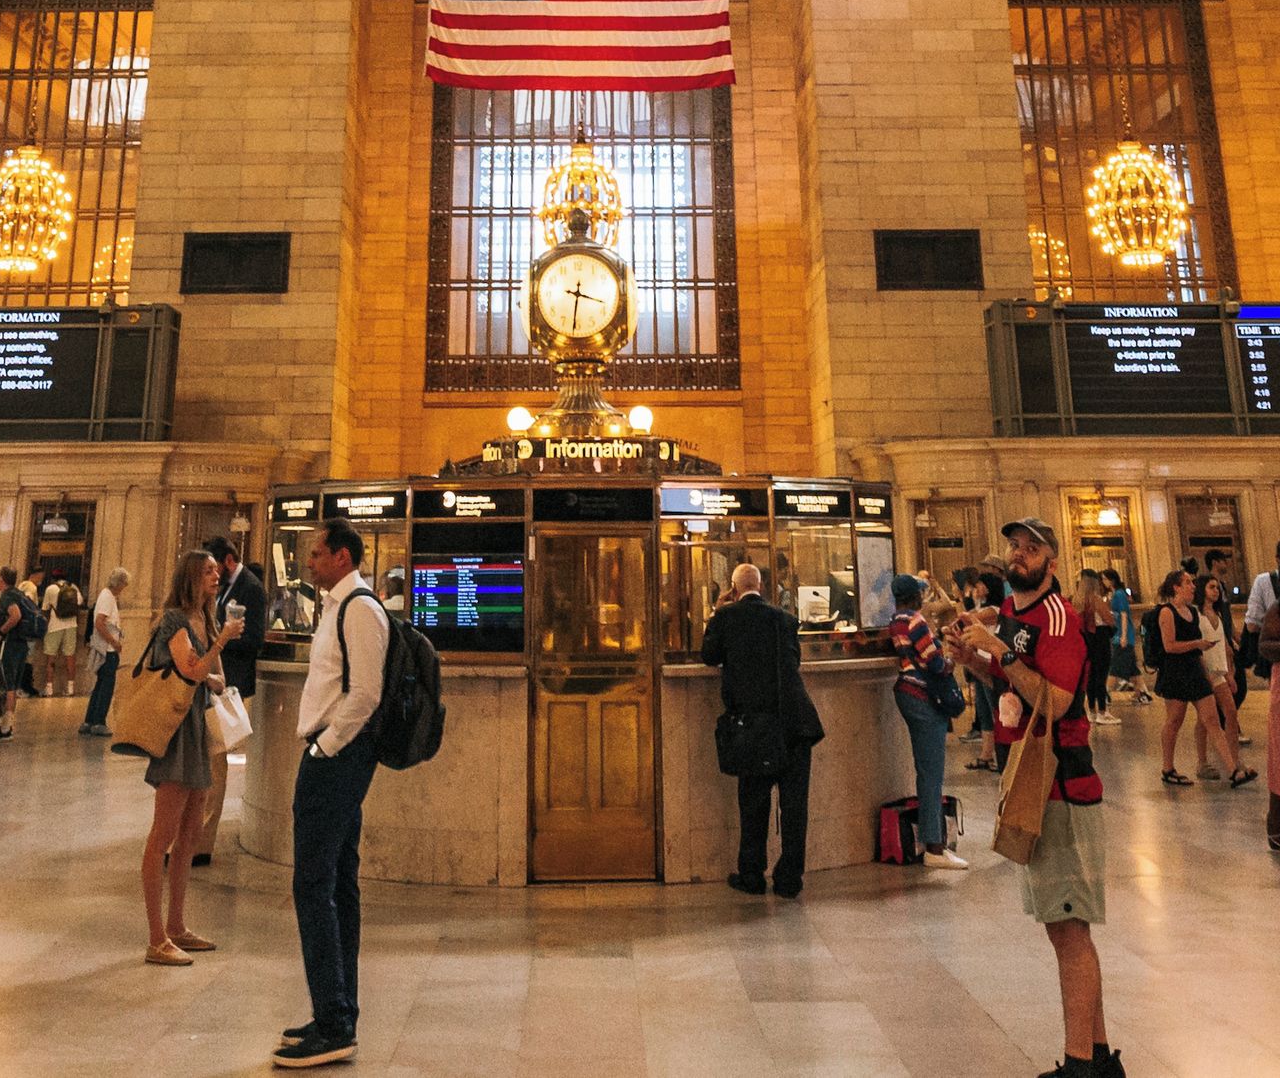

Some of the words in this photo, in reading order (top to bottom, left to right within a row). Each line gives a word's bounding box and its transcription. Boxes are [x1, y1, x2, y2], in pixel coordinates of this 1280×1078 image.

[1104, 307, 1178, 317] INFORMATION
[1091, 326, 1111, 336] Keep
[1122, 326, 1149, 336] moving
[1155, 326, 1180, 336] always
[1181, 327, 1195, 336] pay
[1108, 338, 1120, 347] the
[1121, 338, 1136, 347] fare
[1137, 338, 1152, 347] and
[1153, 339, 1181, 347] activate
[5, 356, 27, 365] police
[1117, 351, 1148, 359] e-tickets
[1149, 351, 1166, 361] prior
[1167, 351, 1175, 359] to
[8, 368, 44, 378] employee
[1115, 363, 1147, 373] boarding
[1148, 364, 1160, 372] the
[546, 438, 642, 459] Information
